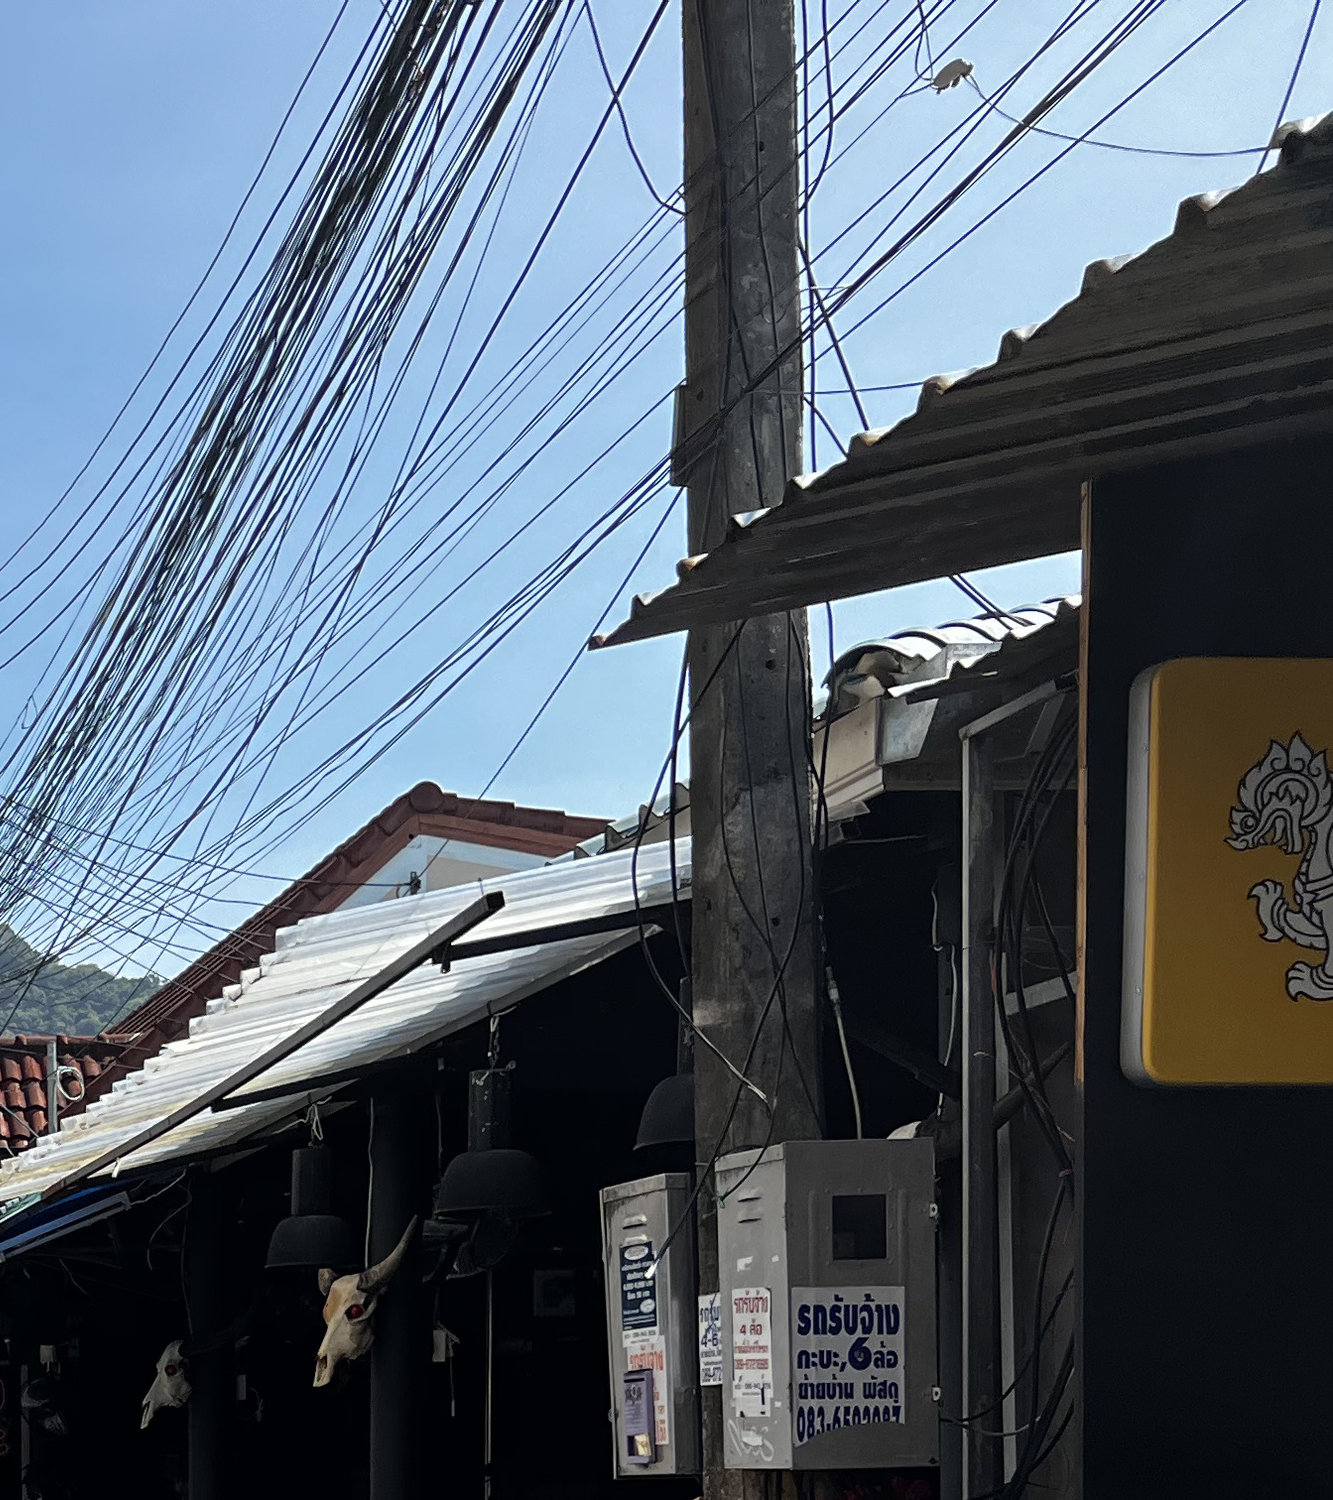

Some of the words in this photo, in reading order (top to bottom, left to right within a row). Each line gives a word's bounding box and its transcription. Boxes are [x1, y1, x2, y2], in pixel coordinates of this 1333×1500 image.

[797, 1293, 900, 1335] รถรับจ้าง
[798, 1374, 854, 1400] ย้ายบ้าน
